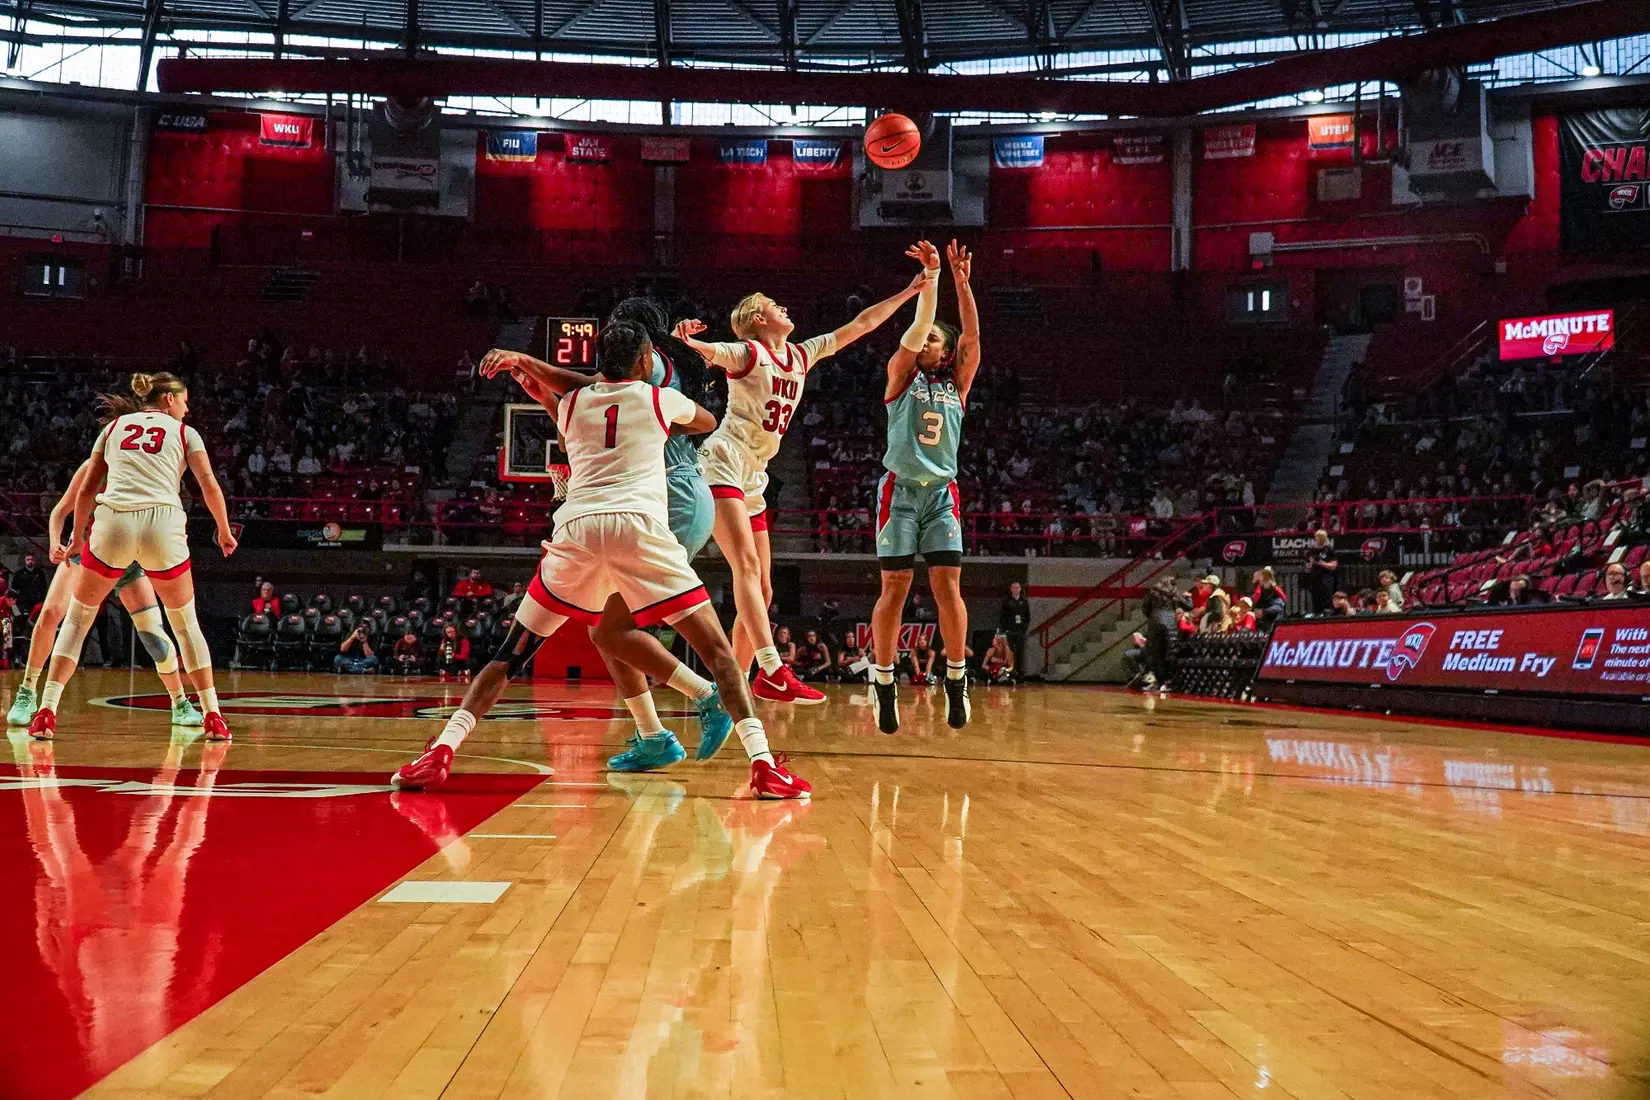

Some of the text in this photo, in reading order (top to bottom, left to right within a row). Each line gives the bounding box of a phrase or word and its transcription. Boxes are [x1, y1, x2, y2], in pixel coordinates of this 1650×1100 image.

[273, 123, 299, 133] WKU
[1320, 125, 1349, 136] UTEP
[503, 139, 520, 149] FIU
[578, 138, 599, 147] JAX
[1430, 143, 1464, 158] ACE
[571, 147, 606, 157] STATE
[795, 147, 841, 157] LIBERTY
[561, 323, 593, 337] 9:49
[1504, 313, 1610, 340] McMINUTE
[556, 338, 588, 363] 21
[771, 375, 799, 401] WKU
[762, 399, 793, 435] 33
[604, 404, 619, 448] 1
[917, 410, 945, 447] 3
[119, 423, 167, 455] 23
[1404, 633, 1425, 650] WKU
[1448, 629, 1504, 651] FREE
[1615, 627, 1648, 642] With
[1263, 639, 1402, 669] McMINUTE
[1610, 643, 1650, 655] The next
[1441, 652, 1556, 679] Medium Fry
[1604, 657, 1638, 668] minute
